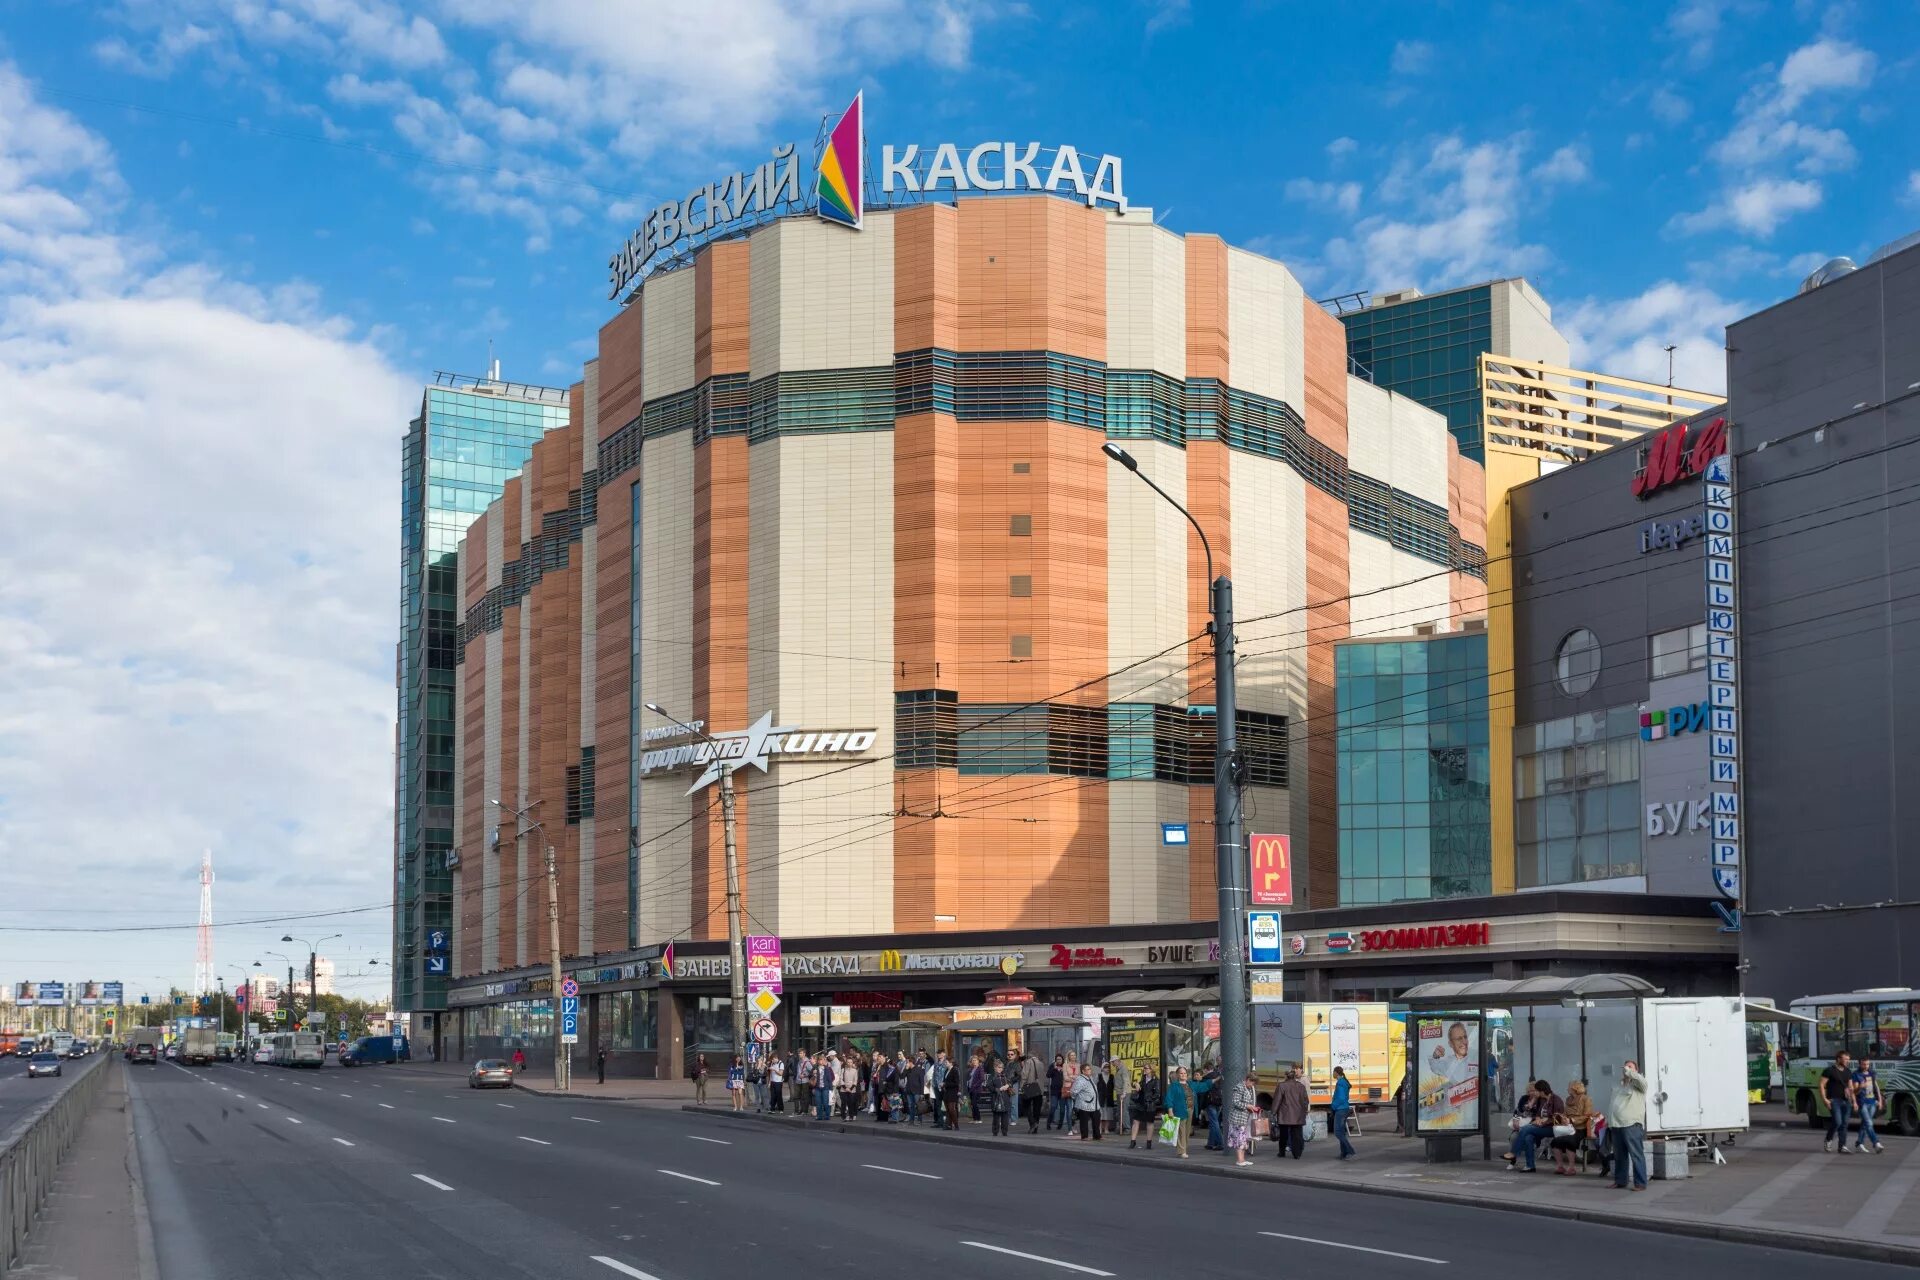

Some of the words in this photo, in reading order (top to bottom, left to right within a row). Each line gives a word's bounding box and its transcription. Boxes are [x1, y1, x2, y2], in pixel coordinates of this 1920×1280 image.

[607, 143, 800, 300] ЗАНЕВСКИЙ
[882, 141, 1128, 215] КАСКАД
[1711, 487, 1734, 780] КОМПЬЮТЕРНЫЙ
[1717, 795, 1735, 863] МИР
[752, 936, 776, 950] kari
[1360, 922, 1490, 952] ЗООМАГАЗИН
[904, 951, 1025, 971] Макдоналс
[1148, 945, 1194, 963] БУШЕ
[785, 954, 861, 975] КАСКАД
[565, 1020, 575, 1032] P
[1117, 1041, 1154, 1060] КИНО
